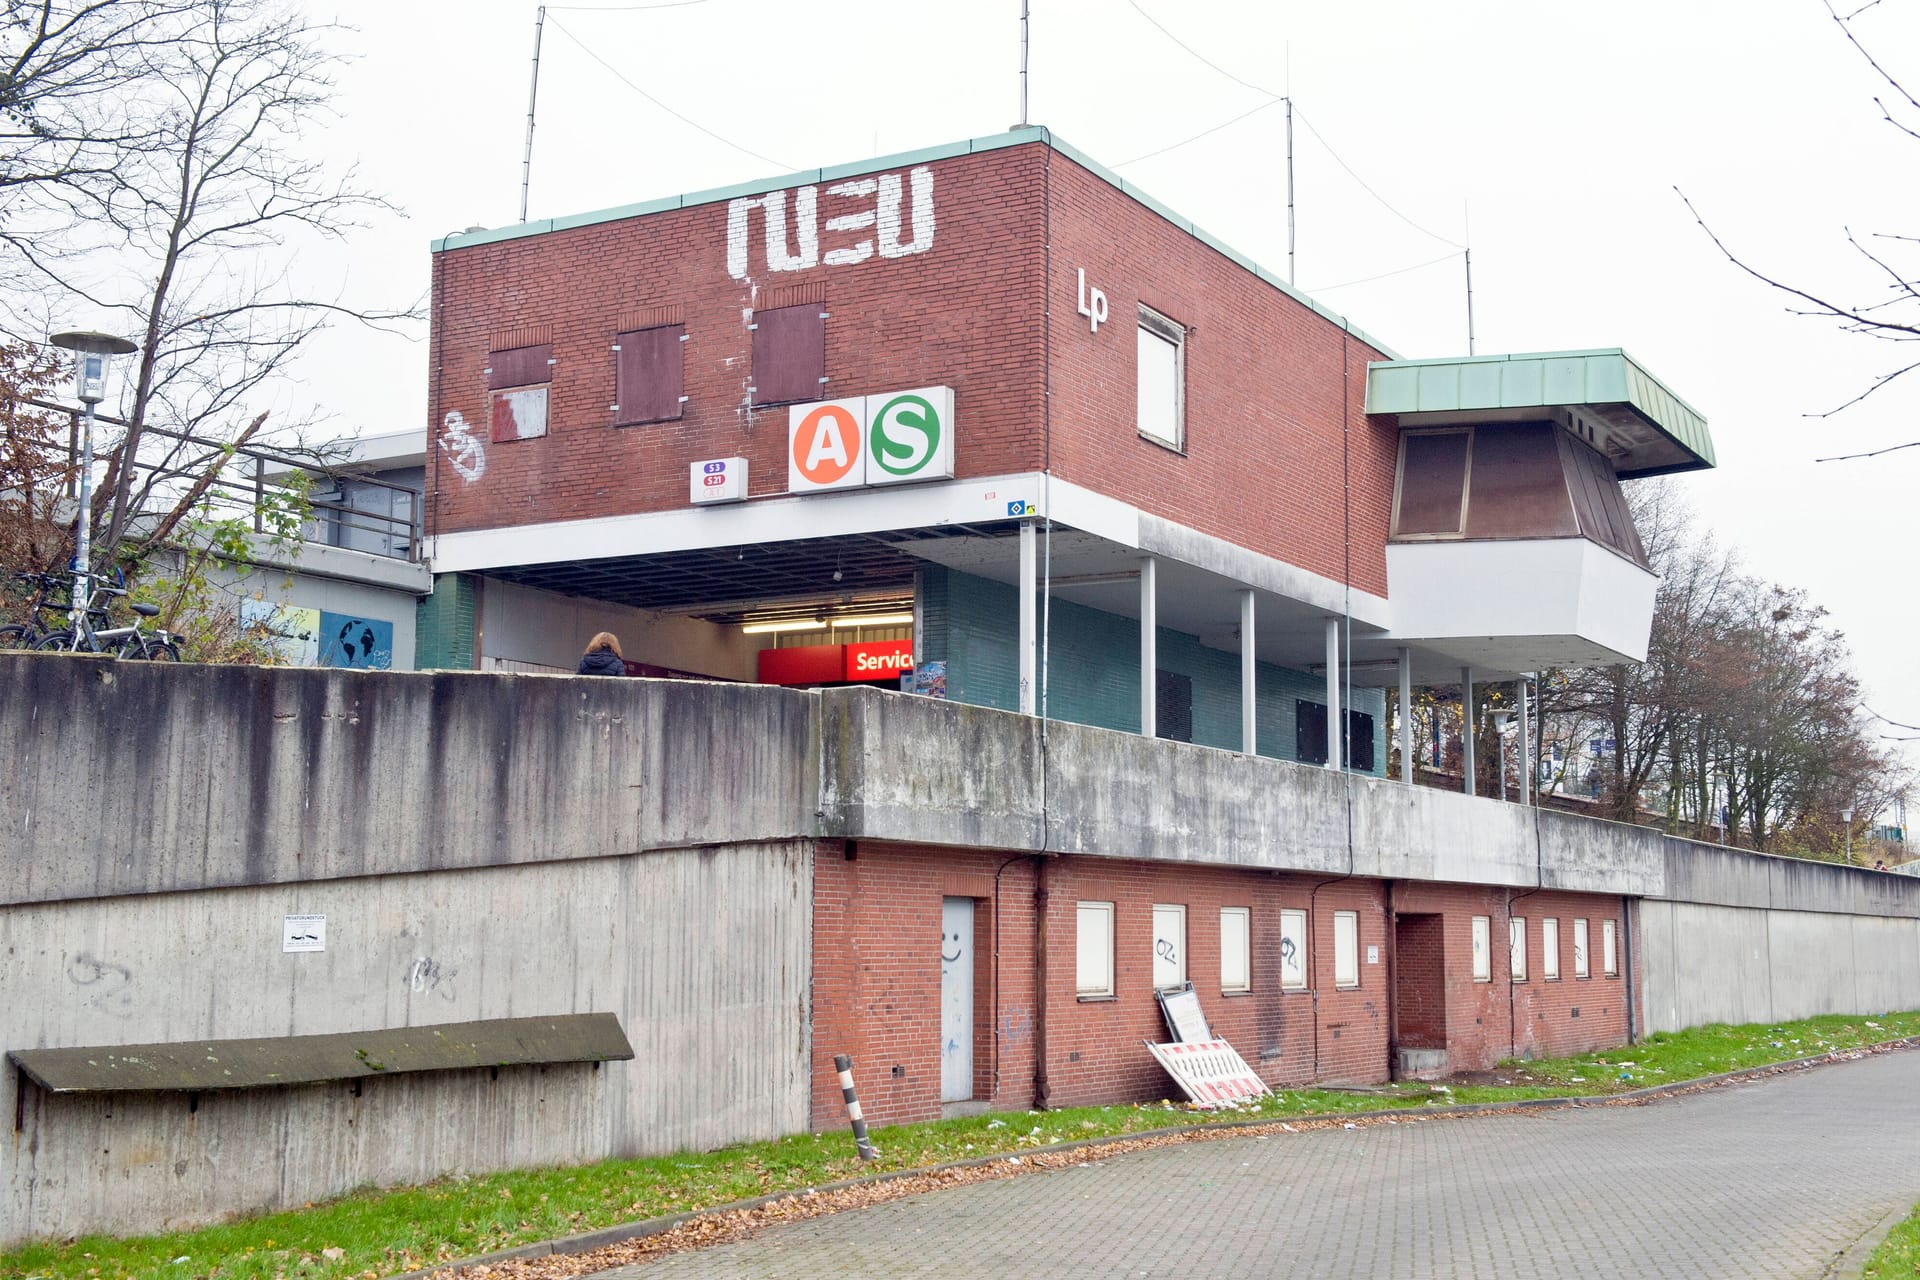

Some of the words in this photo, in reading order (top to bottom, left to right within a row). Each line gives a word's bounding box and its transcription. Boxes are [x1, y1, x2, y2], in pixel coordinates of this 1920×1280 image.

[1078, 267, 1108, 332] Lp
[805, 415, 848, 471] A
[882, 402, 929, 469] S
[707, 476, 722, 485] S21
[709, 464, 720, 472] S3
